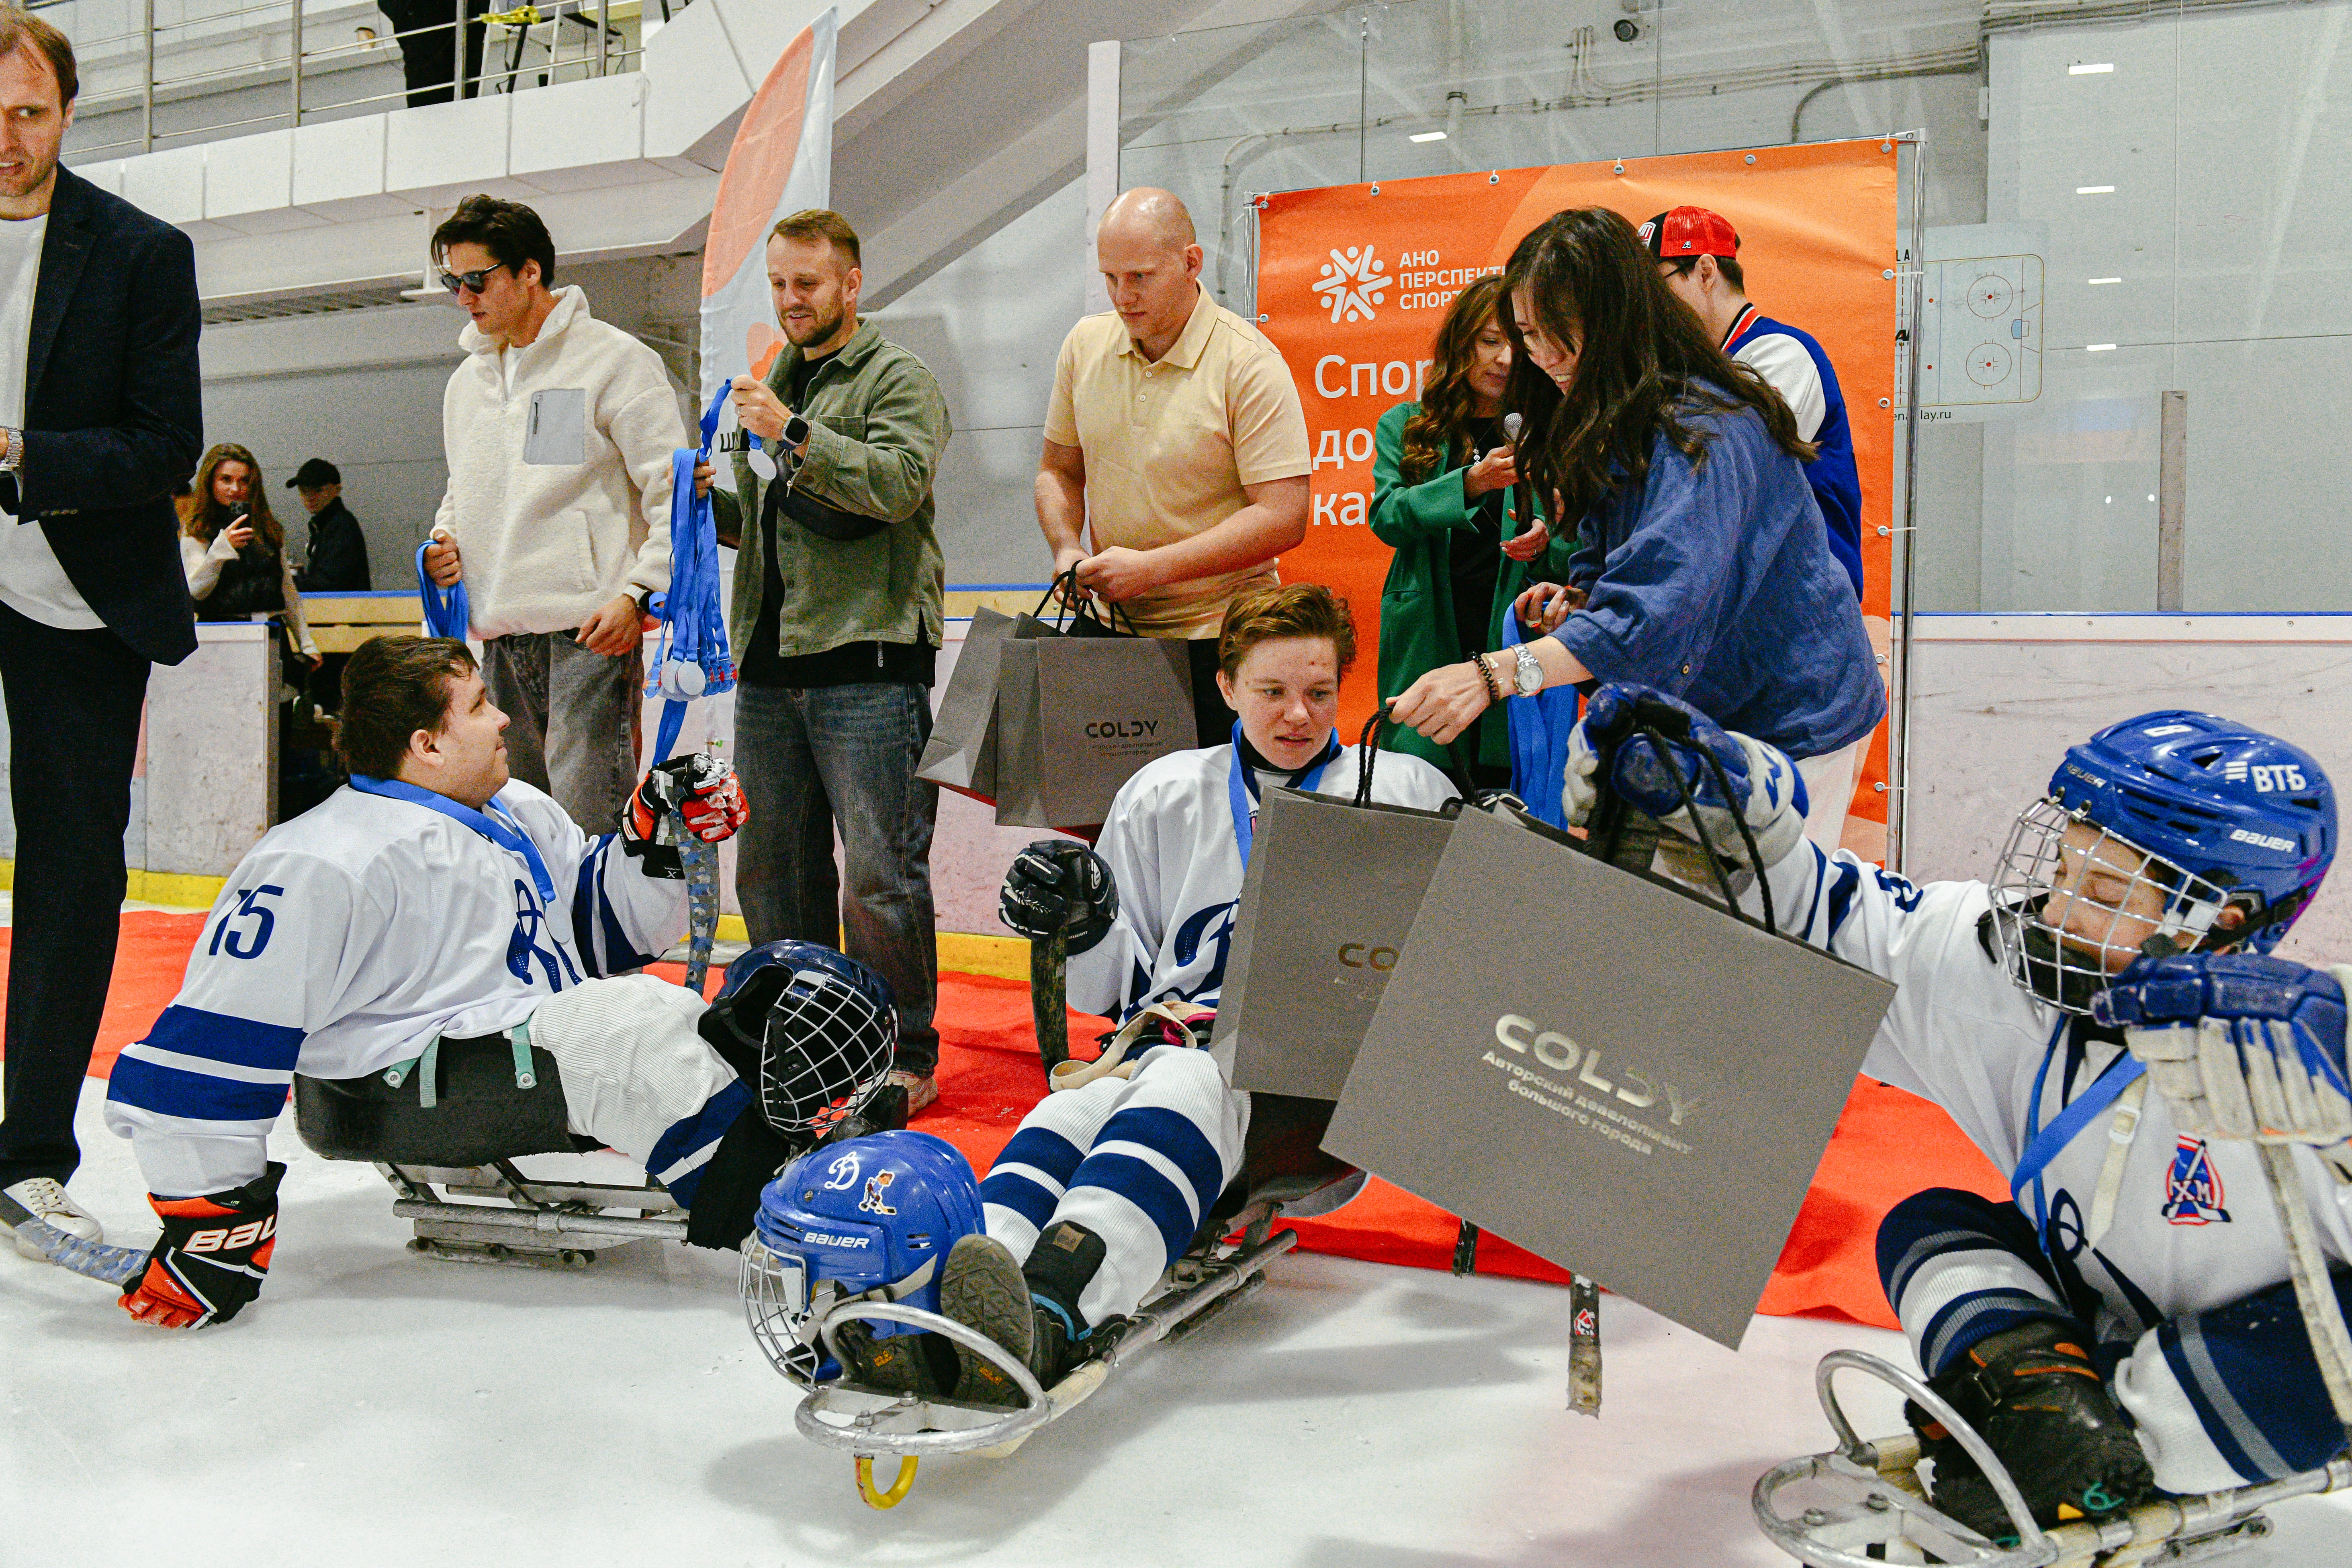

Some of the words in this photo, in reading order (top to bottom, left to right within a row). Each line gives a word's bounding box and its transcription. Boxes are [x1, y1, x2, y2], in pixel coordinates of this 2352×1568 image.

[1399, 250, 1439, 268] АНО
[1313, 428, 1373, 470] до
[1313, 492, 1375, 526] ка
[1086, 720, 1159, 738] COLDY
[2143, 725, 2192, 737] 8
[2251, 765, 2306, 793] ВТБ
[2230, 829, 2295, 853] BAUER
[209, 885, 284, 959] 15
[1495, 1014, 1703, 1125] COLDY
[1481, 1051, 1575, 1100] Авторский
[1575, 1095, 1693, 1154] девелопмент
[1508, 1079, 1589, 1125] большого
[1591, 1120, 1652, 1155] города
[804, 1232, 869, 1249] BAUER
